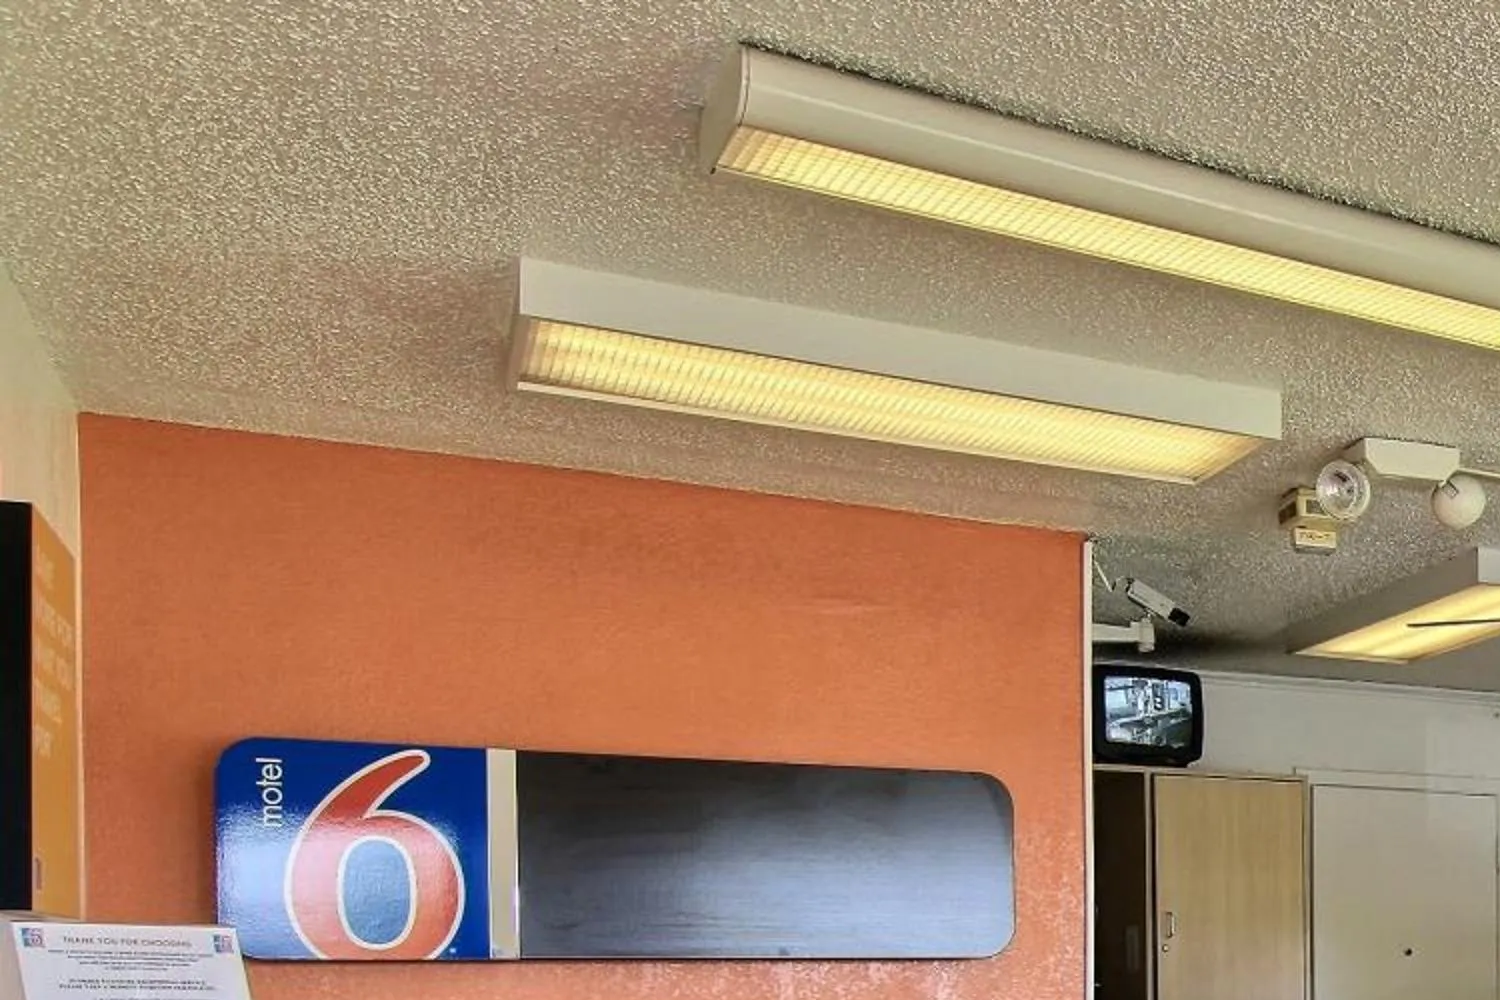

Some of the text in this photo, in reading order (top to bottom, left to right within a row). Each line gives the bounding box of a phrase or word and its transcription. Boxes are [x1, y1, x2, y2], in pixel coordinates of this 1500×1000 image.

[255, 749, 465, 960] motel 6
[64, 936, 94, 944] THANK
[98, 937, 118, 946] YOU
